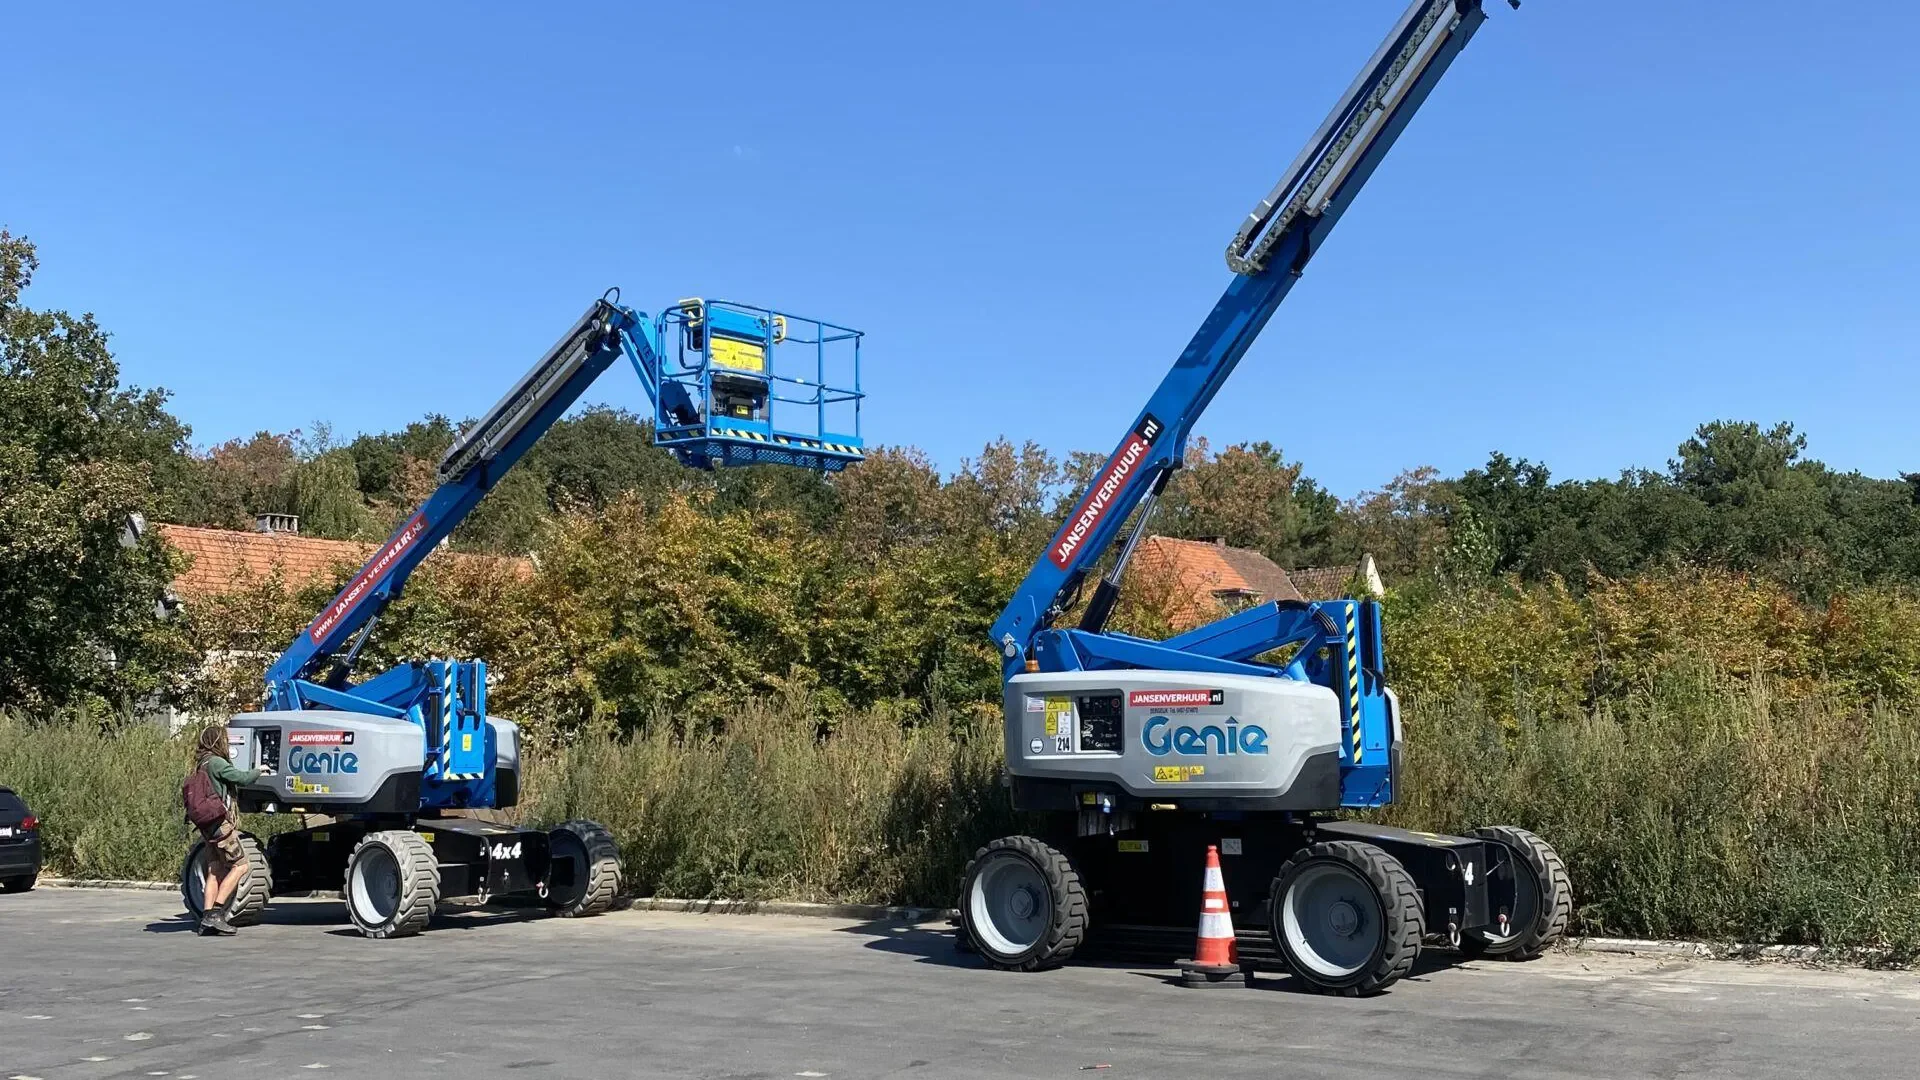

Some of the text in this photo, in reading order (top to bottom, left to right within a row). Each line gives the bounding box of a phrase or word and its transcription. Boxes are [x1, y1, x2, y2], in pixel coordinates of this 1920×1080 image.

[1058, 419, 1159, 563] JANSENVERHUUR.nl
[1132, 692, 1222, 703] JANSENVERHUUR.nl
[1057, 737, 1070, 751] 214
[1141, 715, 1269, 757] Genie
[287, 746, 359, 774] Genie
[492, 842, 522, 860] 4x4
